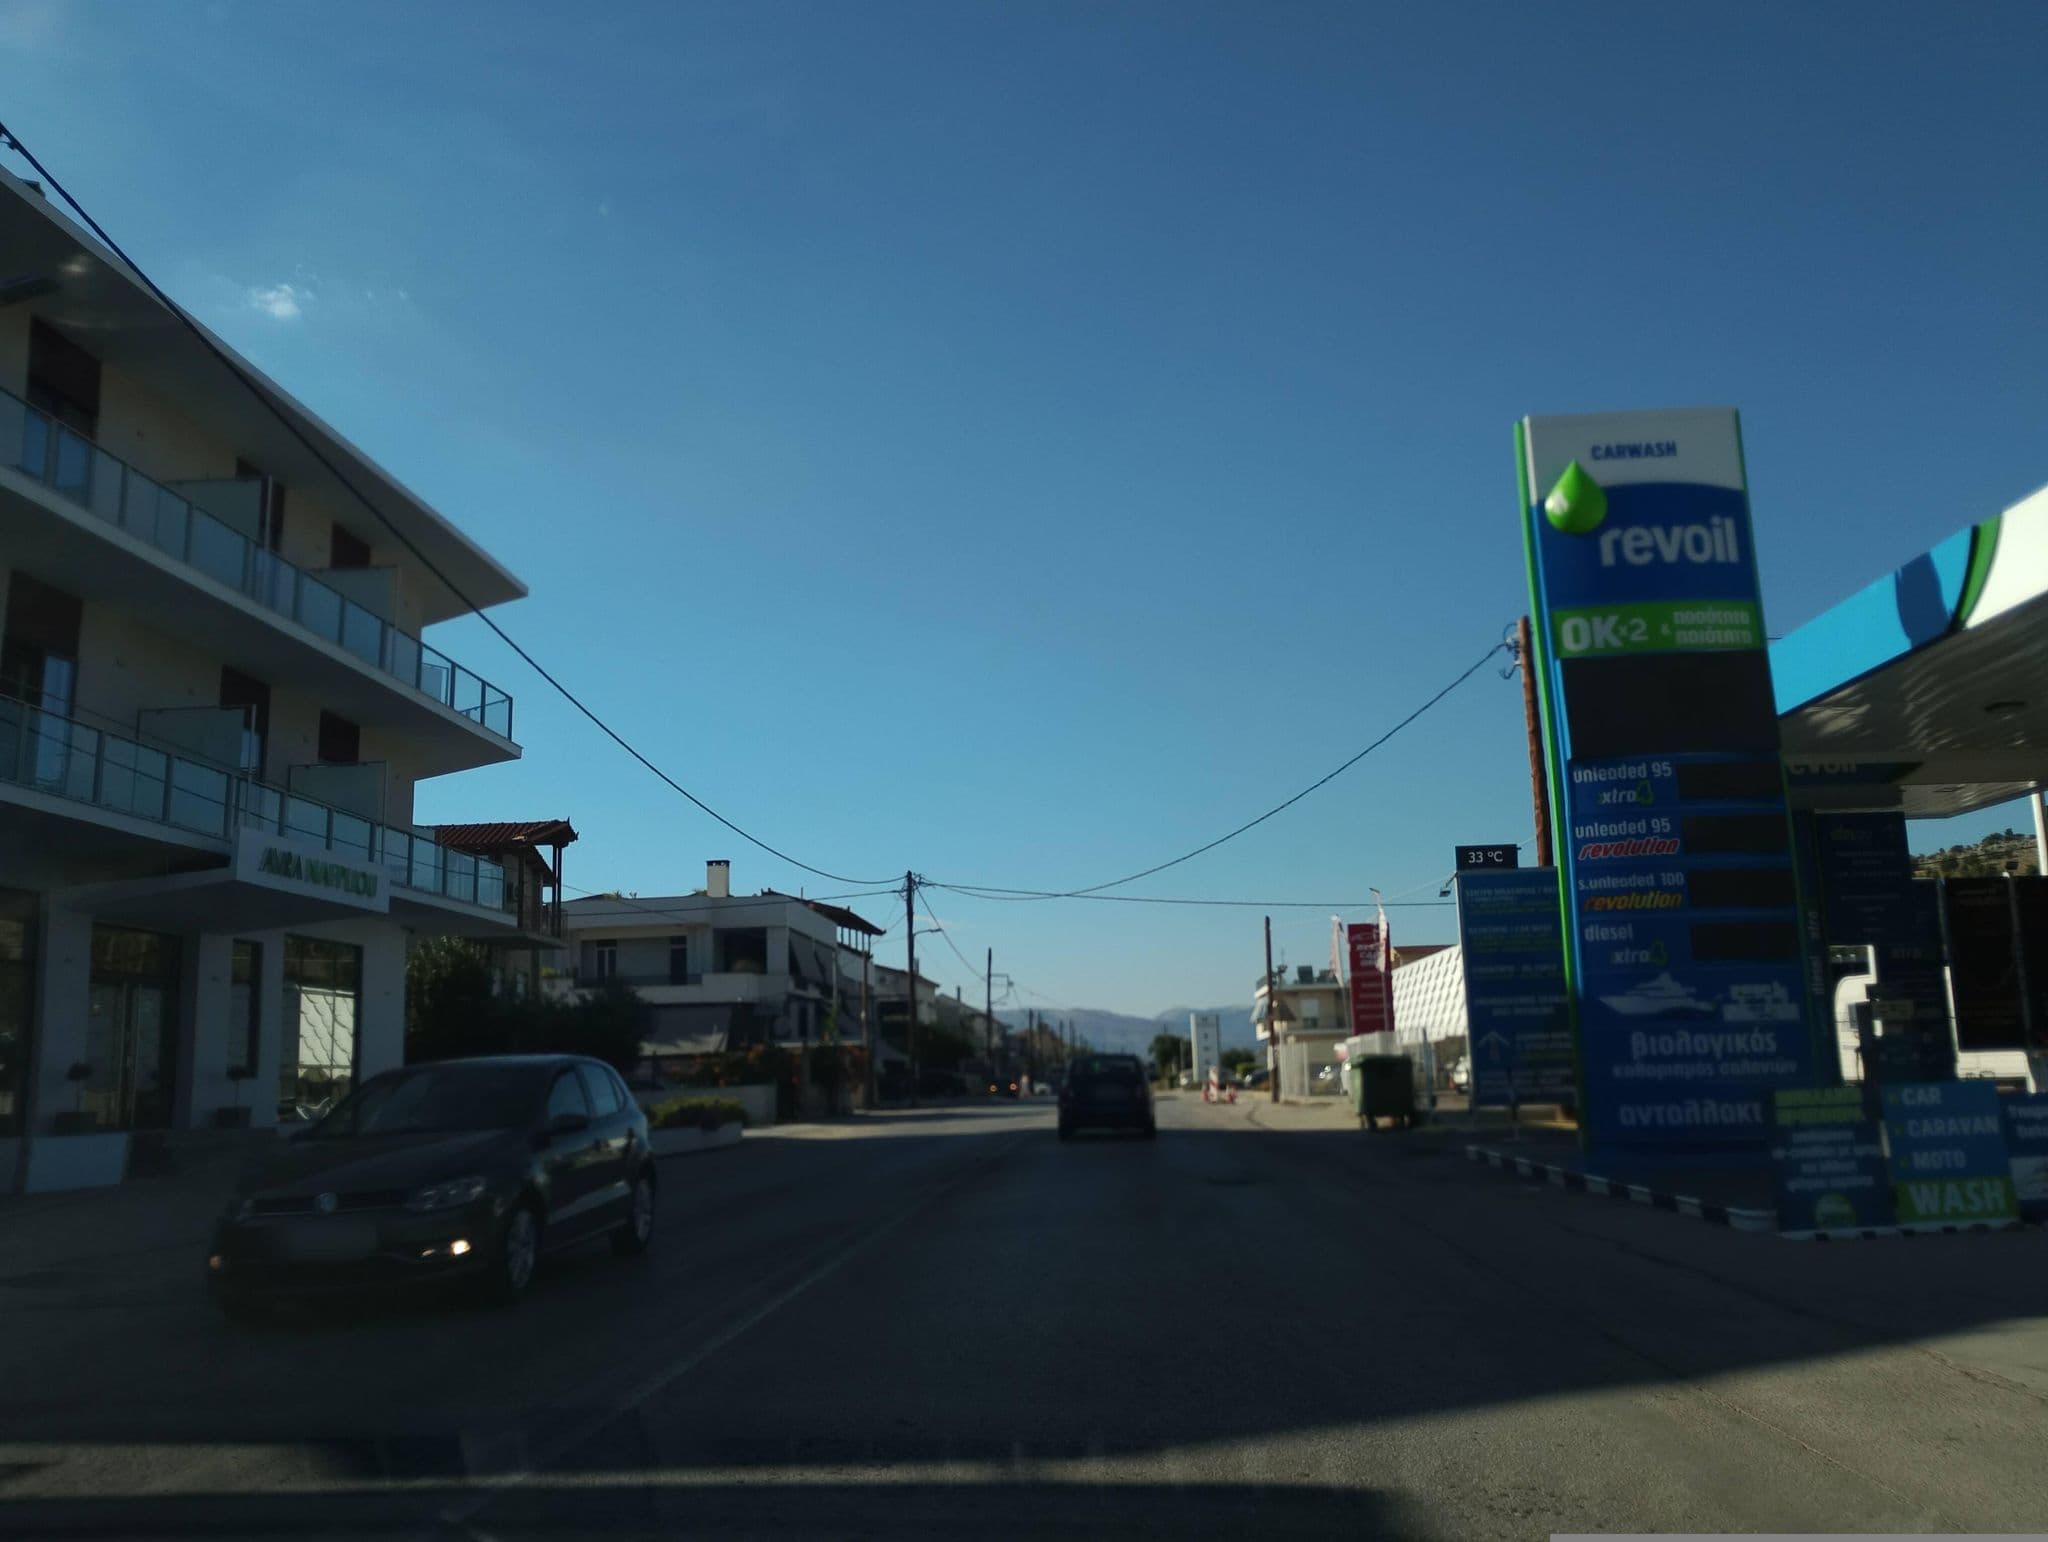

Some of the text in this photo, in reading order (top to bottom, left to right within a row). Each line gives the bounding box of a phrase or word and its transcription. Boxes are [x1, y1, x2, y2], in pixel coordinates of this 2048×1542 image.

[1590, 441, 1677, 460] CARWASH
[1599, 515, 1739, 567] revoil
[1572, 761, 1673, 783] unleaded 95
[1574, 817, 1671, 840] unleaded 95
[1467, 850, 1504, 863] 33 °C
[1577, 837, 1681, 861] revolution
[1578, 872, 1685, 891] s.unleaded 100
[1583, 891, 1682, 911] revolution
[1583, 923, 1635, 943] diesel
[1630, 1026, 1777, 1061] βιολογικός
[1902, 1086, 1942, 1106] CAR
[1906, 1115, 2000, 1138] CARAVAN
[1911, 1149, 1968, 1171] MOTO
[1908, 1179, 2009, 1216] WASH
